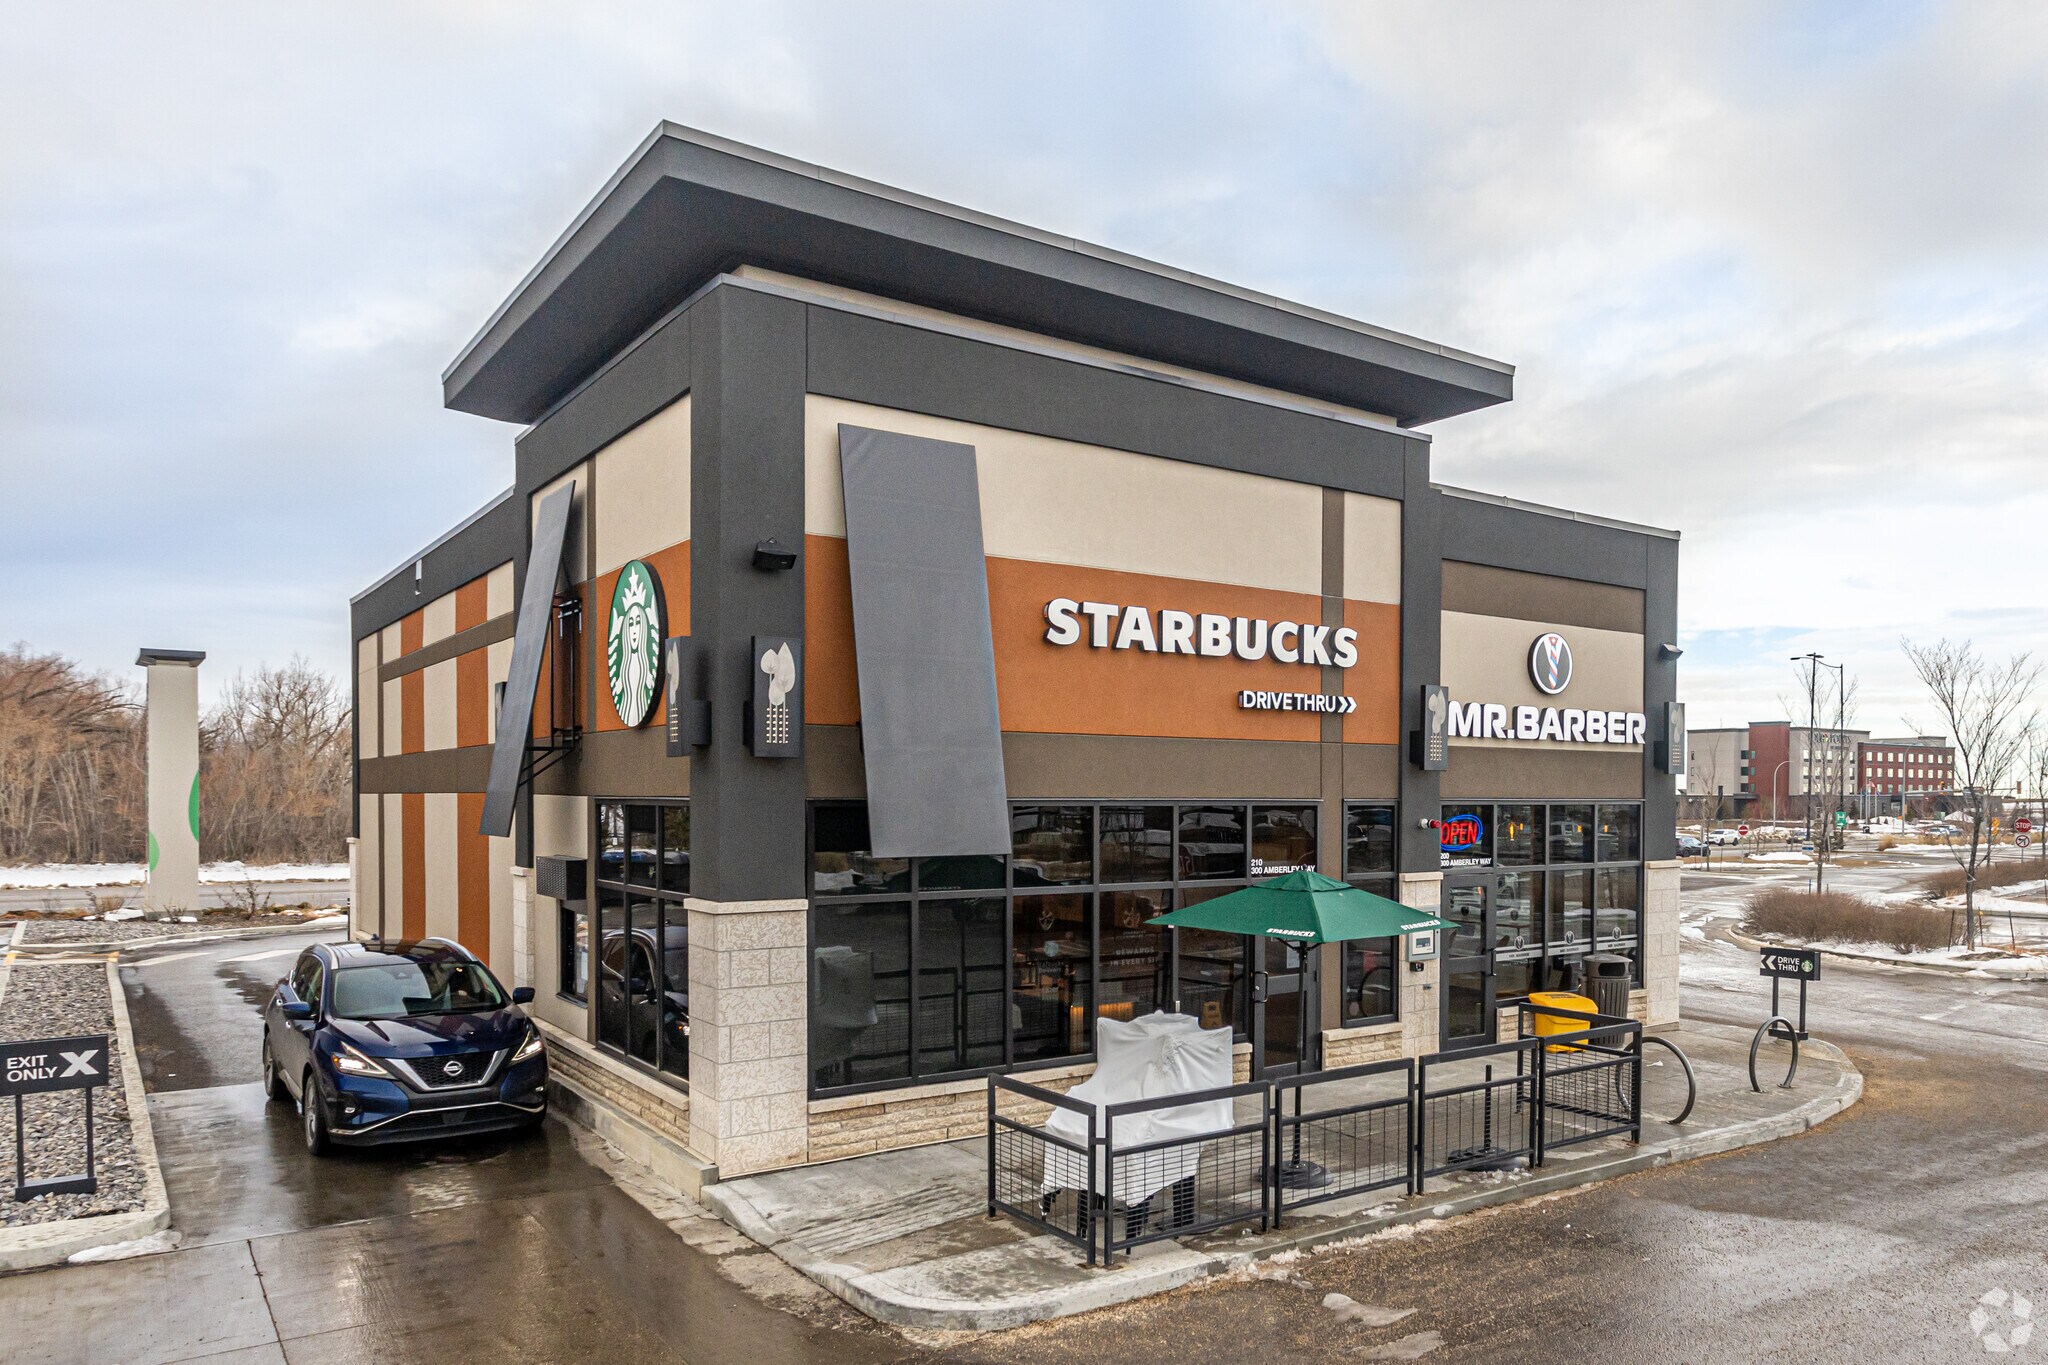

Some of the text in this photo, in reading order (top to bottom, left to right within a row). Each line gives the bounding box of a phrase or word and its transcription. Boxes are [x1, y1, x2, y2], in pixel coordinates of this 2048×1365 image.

[1046, 597, 1359, 669] STARBUCKS
[1242, 689, 1337, 713] DRIVE THRU
[1440, 820, 1479, 845] OPEN
[1250, 858, 1263, 867] 210
[1450, 858, 1480, 867] AMBERLEY
[1480, 857, 1492, 865] WAY
[1250, 866, 1263, 875] 300
[1263, 865, 1300, 875] AMBERLEY
[1400, 919, 1442, 931] STARBUCKS
[1265, 927, 1316, 938] STARBUCKS
[1777, 956, 1800, 965] DRIVE
[1778, 964, 1799, 973] THRU
[6, 1054, 48, 1070] EXIT
[6, 1066, 58, 1082] ONLY
